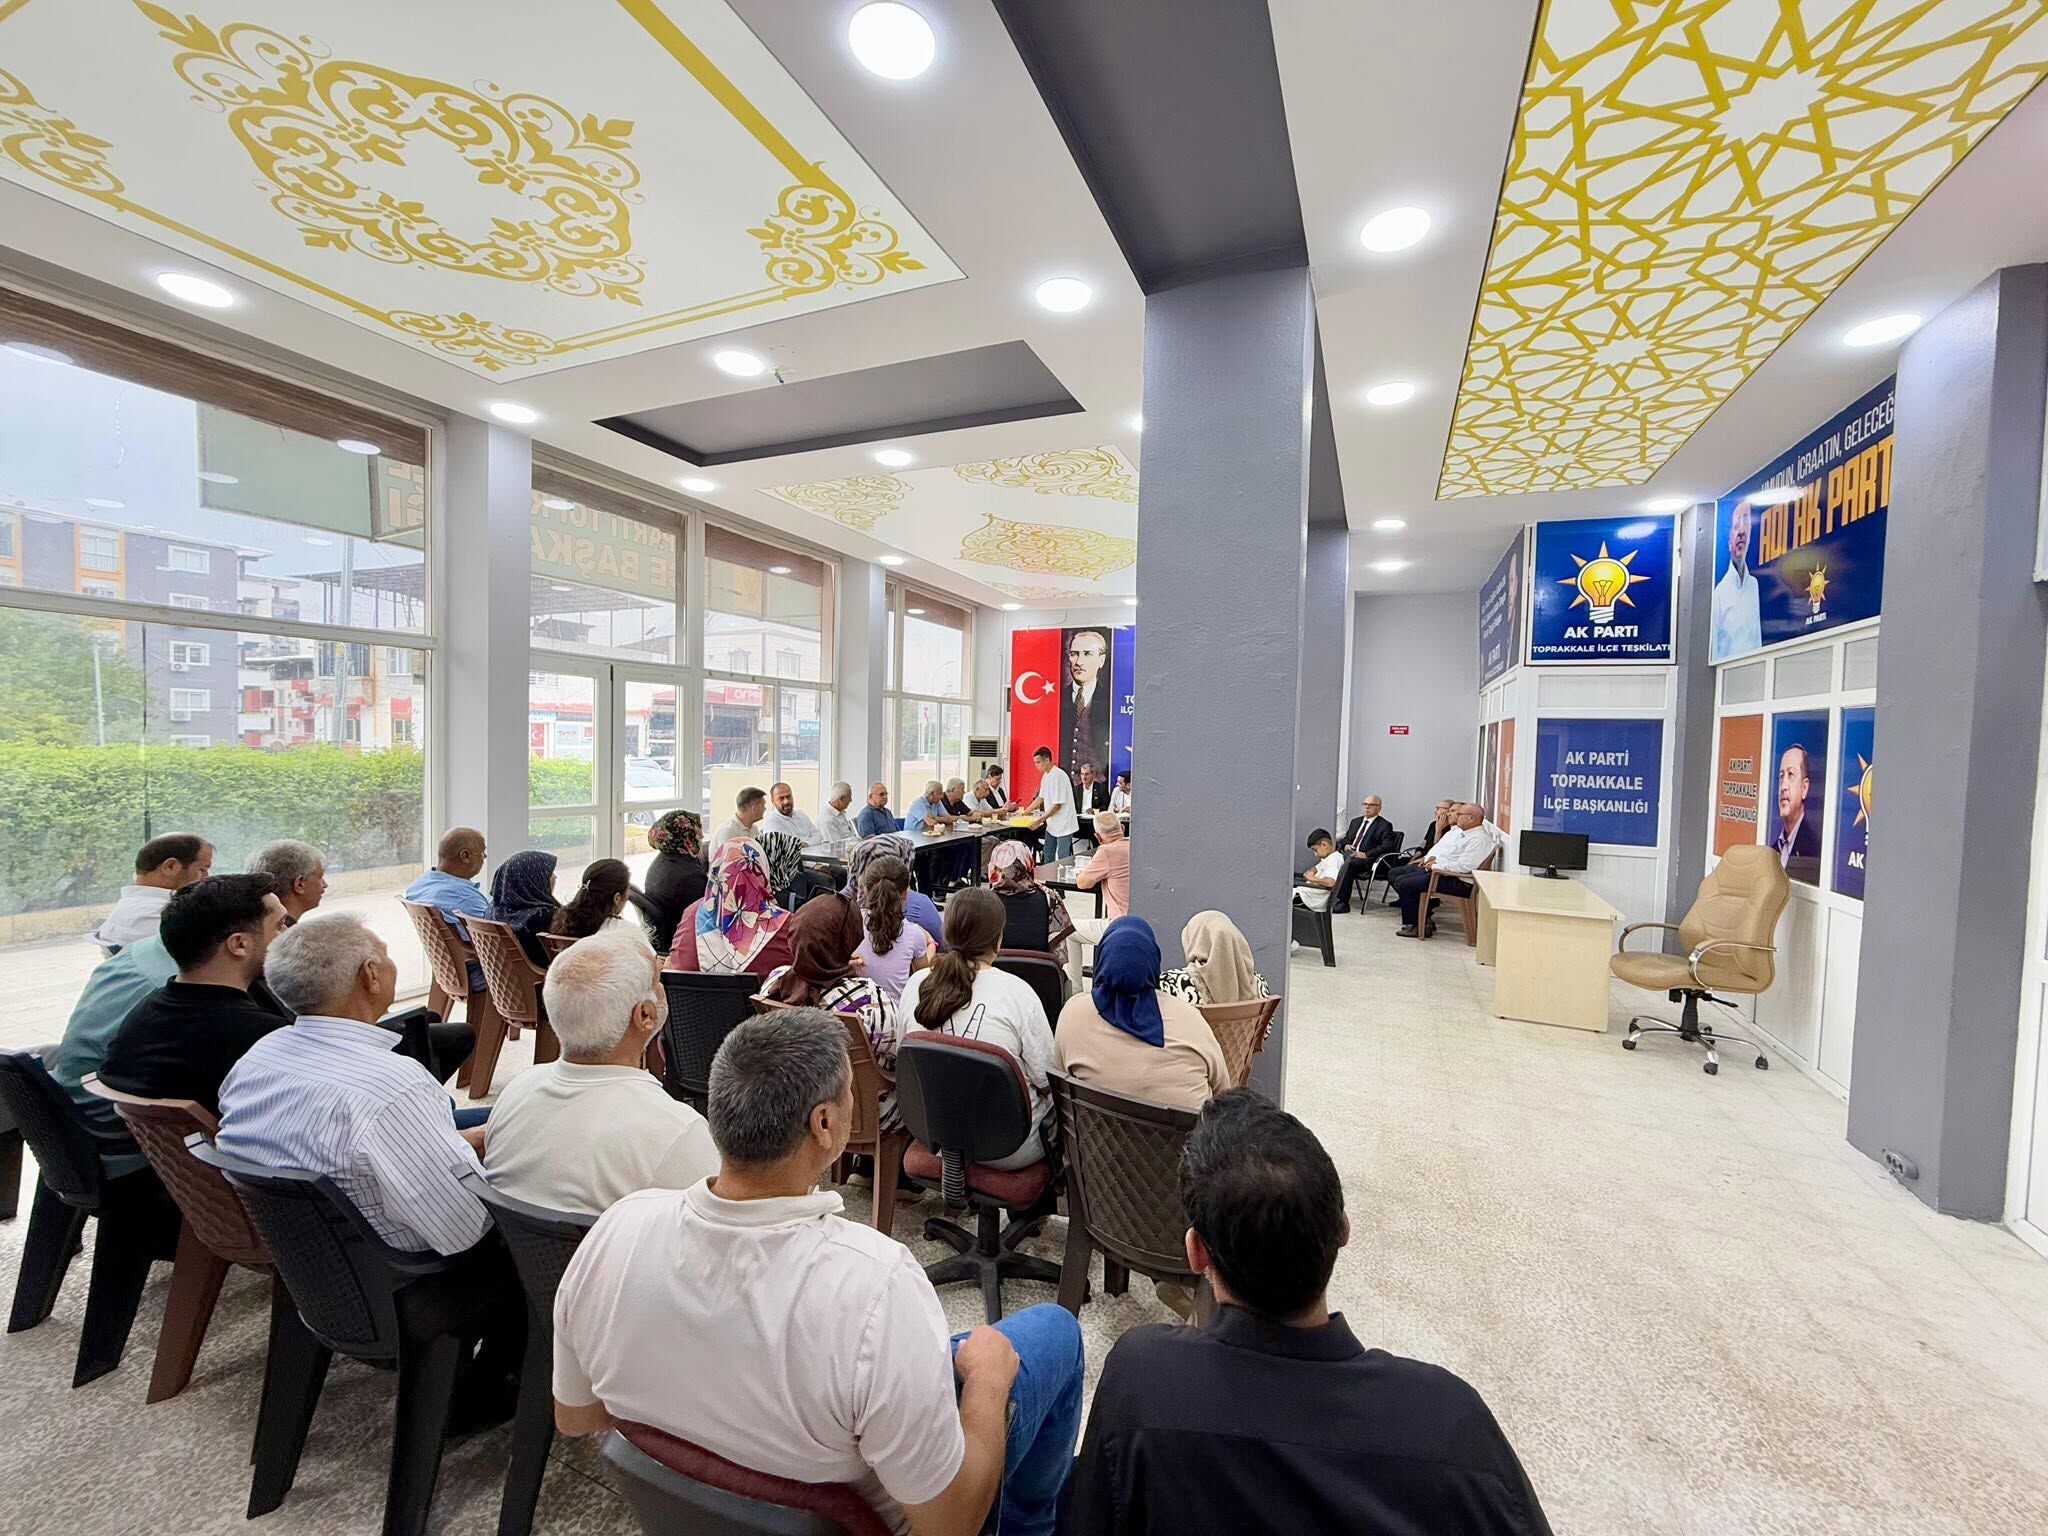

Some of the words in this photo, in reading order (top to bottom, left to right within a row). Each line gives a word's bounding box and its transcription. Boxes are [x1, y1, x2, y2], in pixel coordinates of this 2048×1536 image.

[1797, 431, 1842, 481] İCRAATIN,
[1844, 391, 1894, 451] GELECEĞ
[1758, 503, 1790, 566] ADI
[1793, 477, 1822, 550] AK
[1826, 433, 1896, 534] PART
[1563, 626, 1589, 639] AK
[1593, 625, 1639, 638] PARTİ
[1533, 645, 1595, 653] TOPRAKKALE
[1597, 643, 1619, 653] İLÇE
[1621, 642, 1672, 653] TEŞKİLATI
[1565, 751, 1585, 765] AK
[1588, 749, 1629, 766] PARTİ
[1550, 774, 1643, 790] TOPRAKKALE
[1543, 795, 1570, 812] İLÇE
[1573, 798, 1648, 814] BAŞKANLIĞI
[1848, 851, 1865, 869] AK
